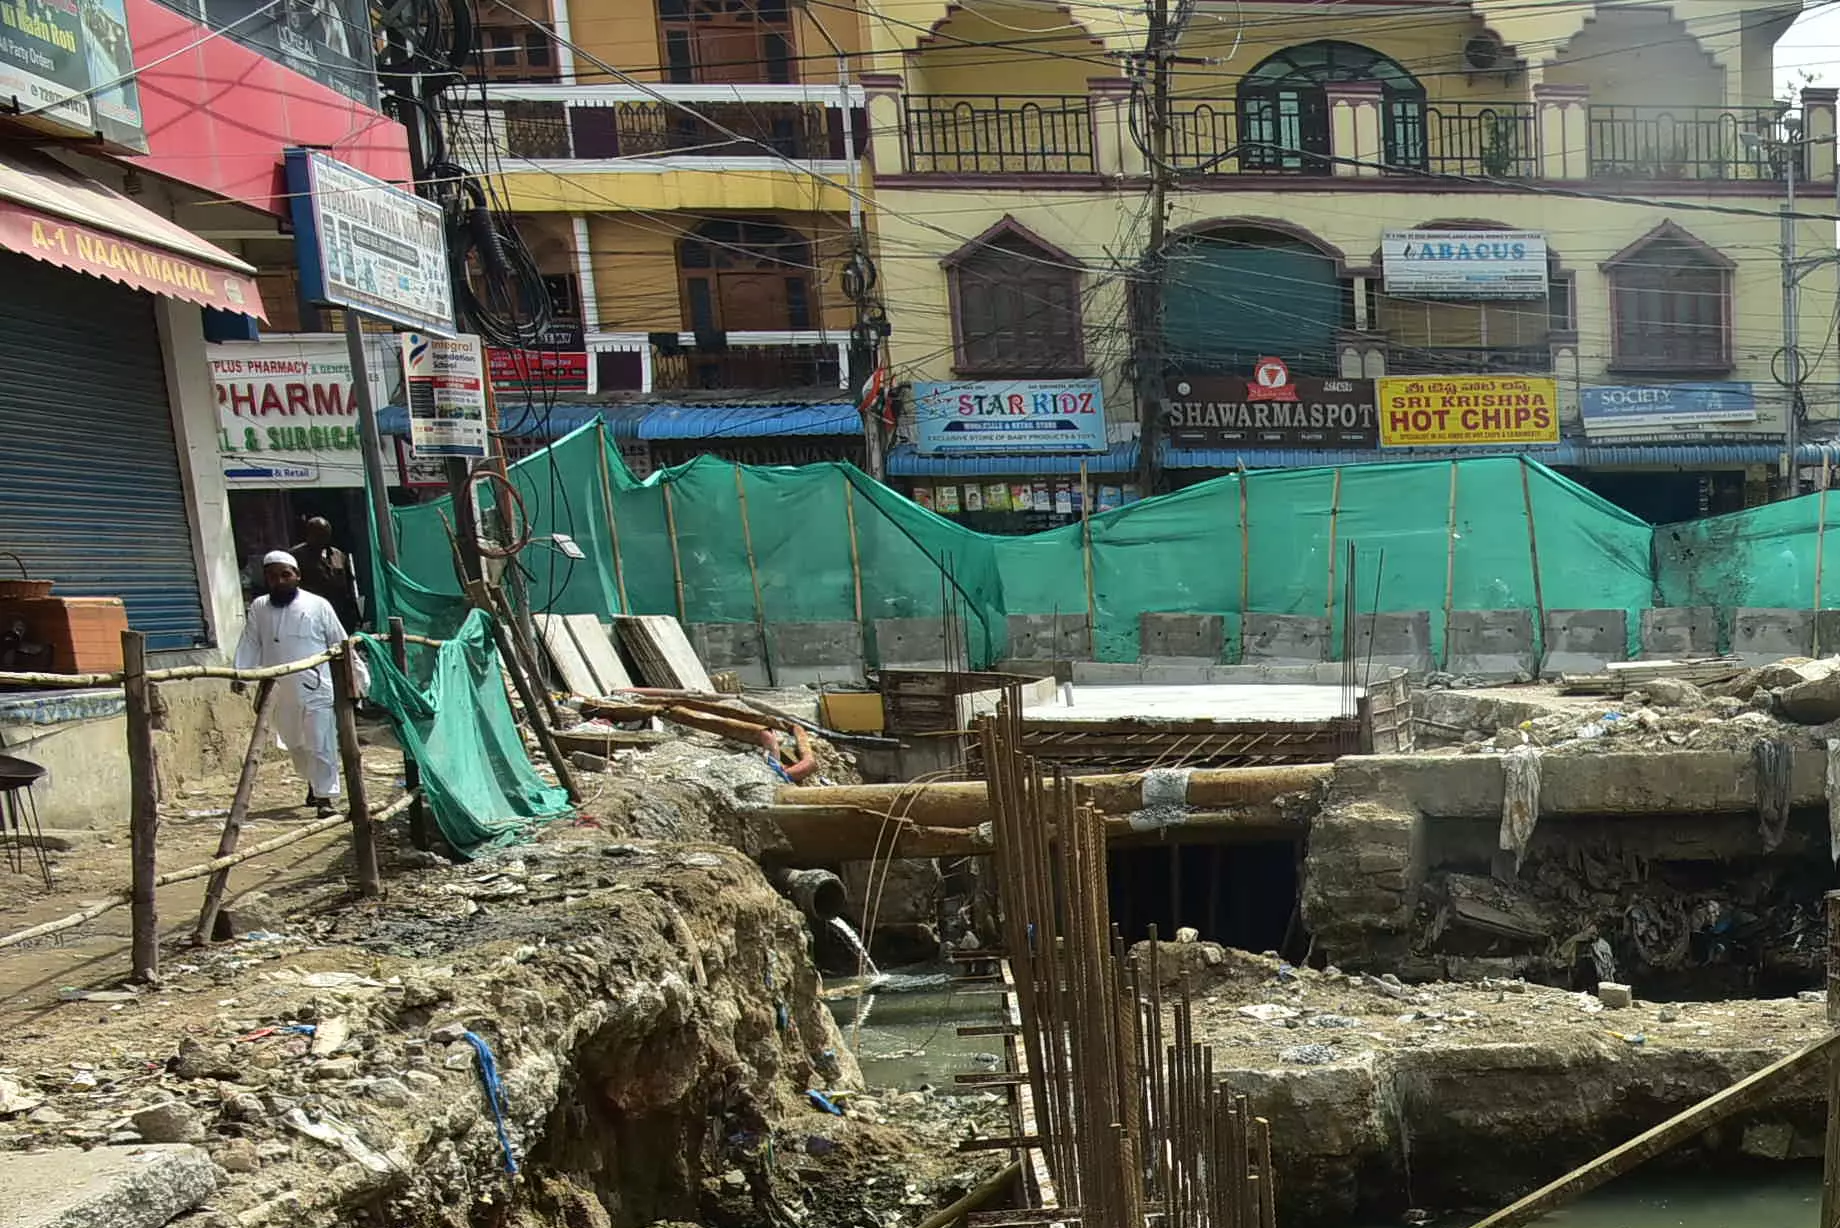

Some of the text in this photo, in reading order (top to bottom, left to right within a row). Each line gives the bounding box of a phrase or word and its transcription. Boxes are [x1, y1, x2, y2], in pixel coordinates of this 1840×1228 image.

[31, 221, 216, 296] A-1 NAAN MAHAL
[1419, 242, 1526, 260] ABACUS
[214, 360, 242, 374] PLUS
[247, 360, 309, 374] PHARMACY
[958, 392, 1097, 416] STAR KIDZ
[1391, 394, 1546, 409] SRI KRISHNA
[1600, 388, 1673, 405] SOCIETY
[1390, 407, 1550, 432] HOT CHIPS
[243, 426, 260, 452] &
[969, 433, 994, 441] STORE
[995, 433, 1005, 441] OF
[1007, 433, 1027, 441] BABY
[284, 469, 309, 477] Retail
